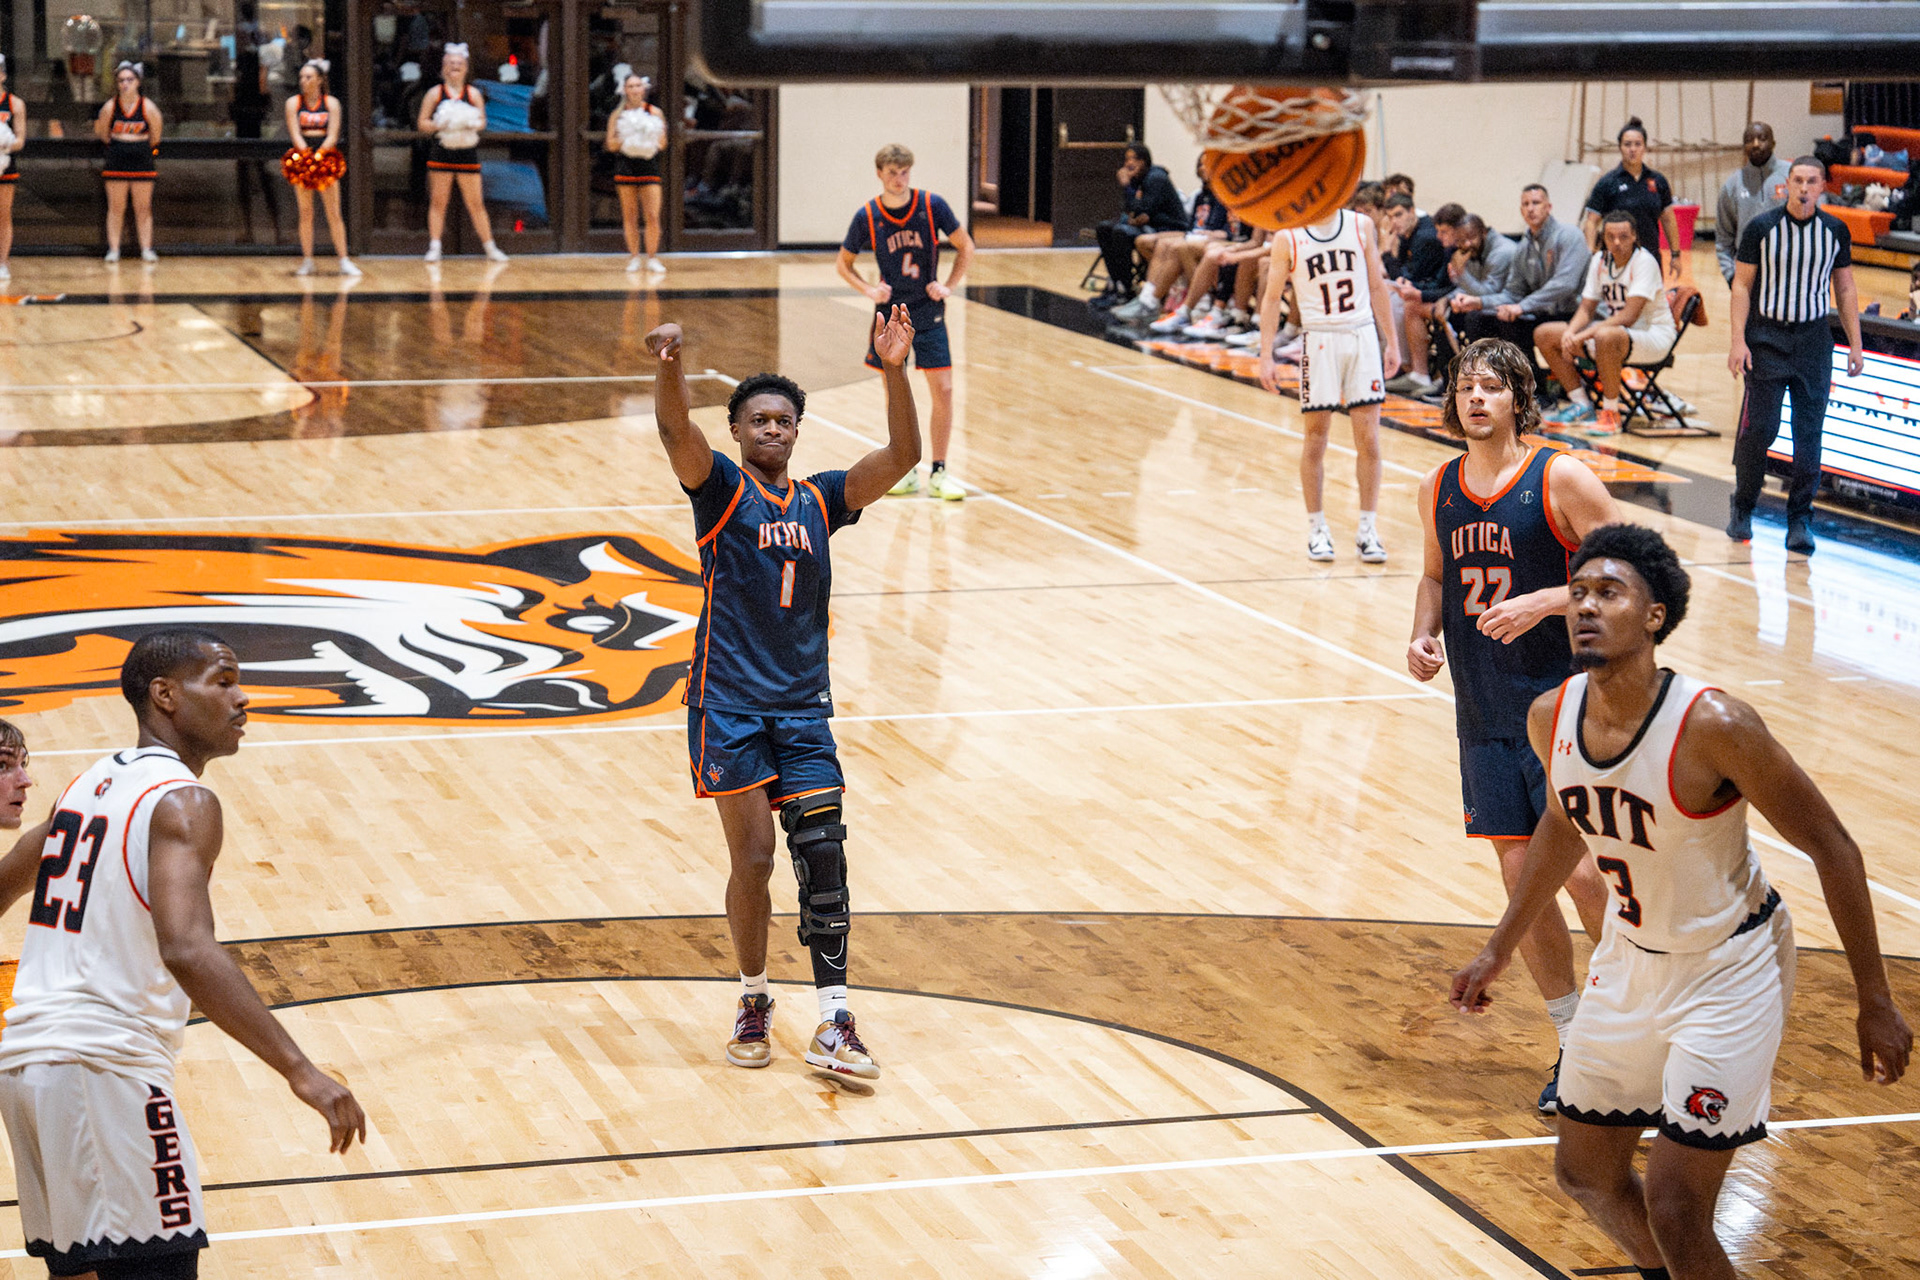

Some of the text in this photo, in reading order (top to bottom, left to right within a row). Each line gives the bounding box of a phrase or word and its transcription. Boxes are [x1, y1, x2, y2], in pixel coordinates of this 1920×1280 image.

[886, 229, 924, 254] UTICA
[901, 252, 920, 280] 4
[1305, 249, 1356, 281] RIT
[1319, 278, 1355, 316] 12
[1602, 283, 1627, 303] RIT
[1301, 331, 1310, 404] TIGERS
[758, 521, 813, 556] UTICA
[1451, 521, 1515, 560] UTICA
[779, 560, 796, 608] 1
[1460, 566, 1512, 616] 22
[1558, 785, 1657, 852] RIT
[28, 808, 109, 934] 23
[1597, 855, 1642, 928] 3
